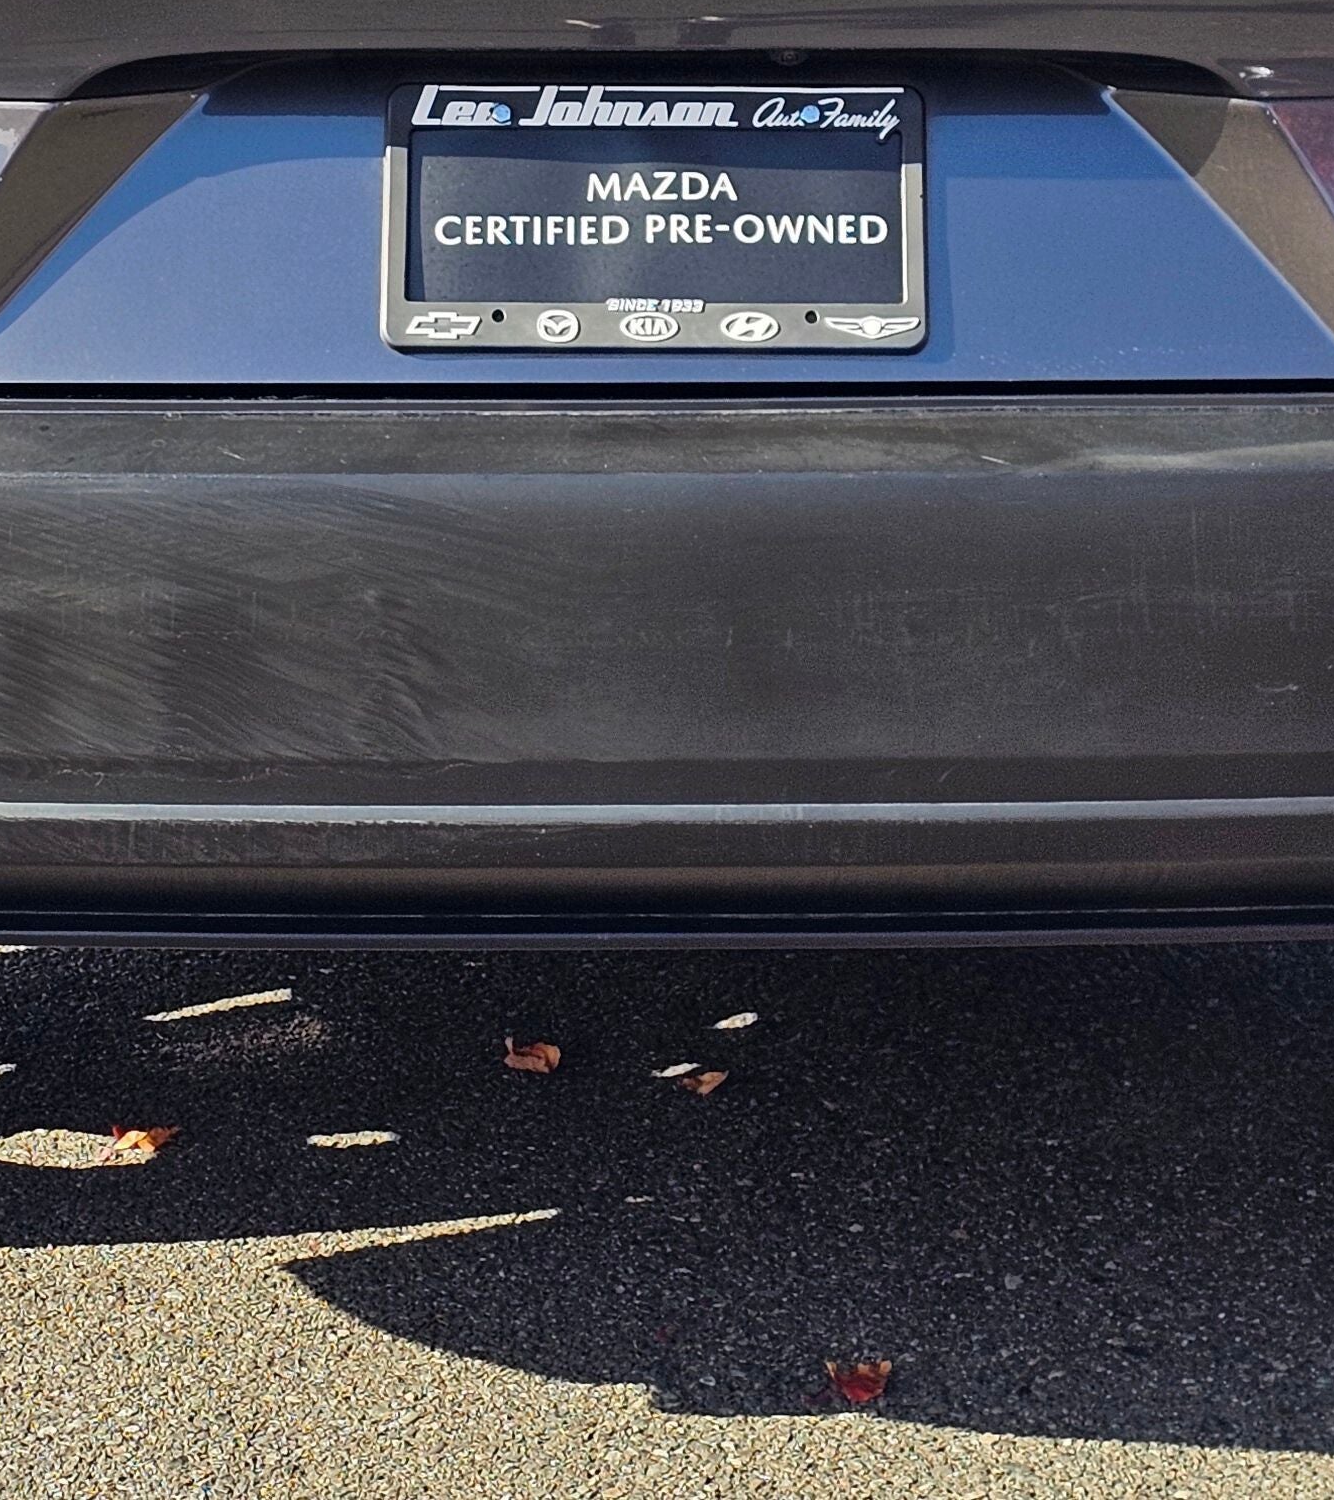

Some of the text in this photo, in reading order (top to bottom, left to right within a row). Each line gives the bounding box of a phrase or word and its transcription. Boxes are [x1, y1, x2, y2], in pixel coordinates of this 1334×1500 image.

[518, 85, 739, 127] Johnson
[752, 97, 820, 128] Aut
[818, 97, 901, 140] Family
[586, 171, 738, 202] MAZDA
[434, 213, 888, 246] CERTIFIED PRE-OWNED
[606, 298, 658, 312] SINCE
[627, 316, 669, 336] KIA
